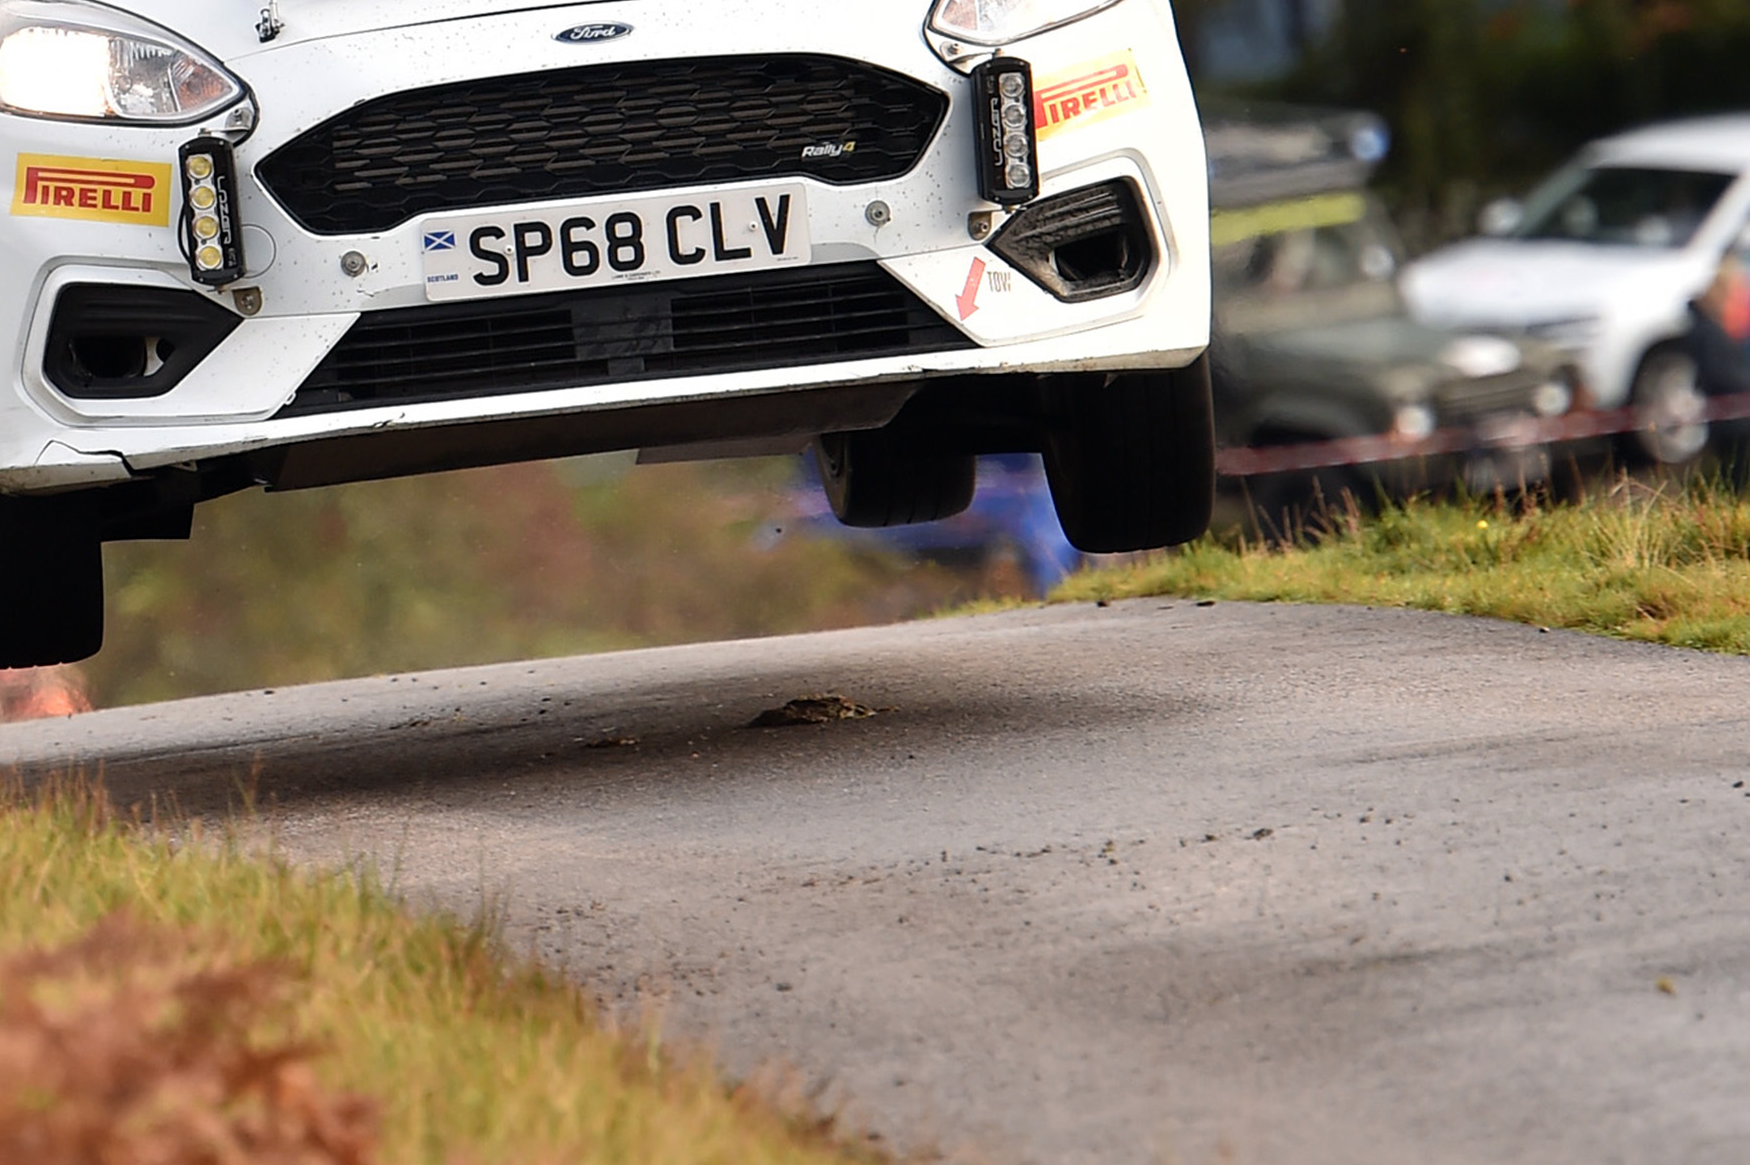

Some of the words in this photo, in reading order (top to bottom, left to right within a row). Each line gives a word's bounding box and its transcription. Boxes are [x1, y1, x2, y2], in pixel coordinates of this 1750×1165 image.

[570, 25, 616, 40] Ford
[1034, 63, 1137, 130] PIRELLI
[23, 166, 156, 213] PIRELLI
[468, 211, 647, 287] SP68
[665, 193, 792, 266] CLV
